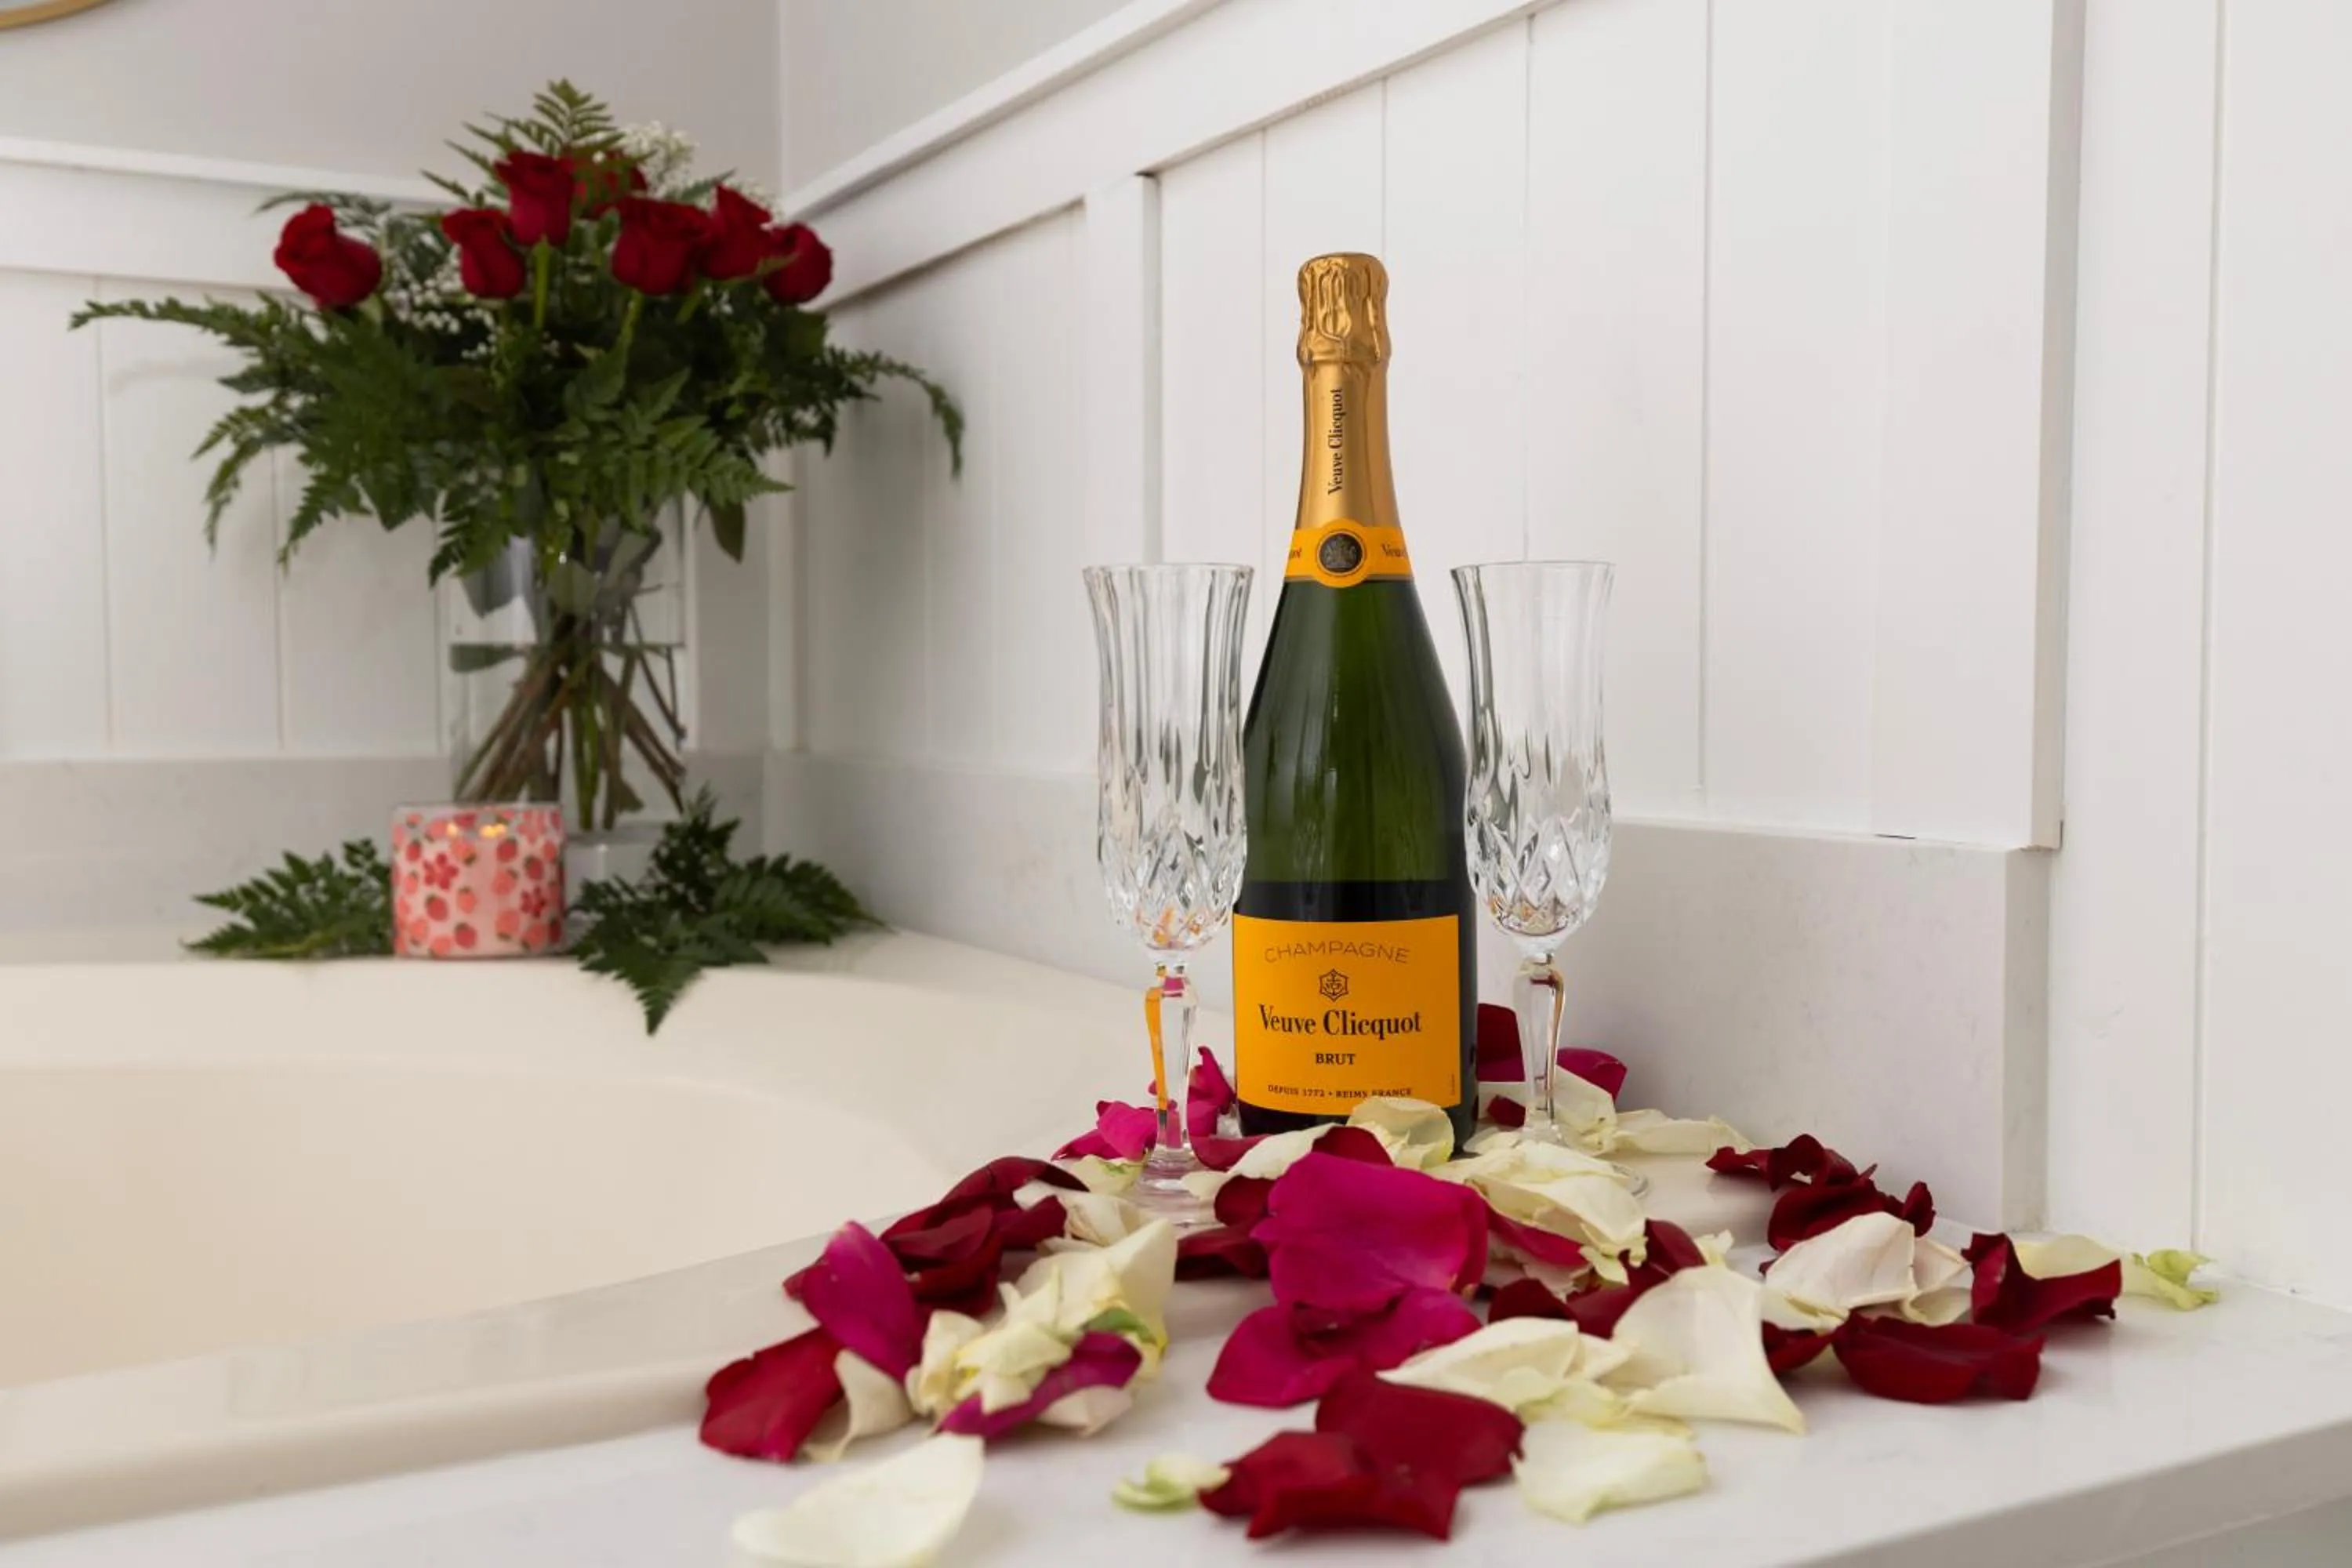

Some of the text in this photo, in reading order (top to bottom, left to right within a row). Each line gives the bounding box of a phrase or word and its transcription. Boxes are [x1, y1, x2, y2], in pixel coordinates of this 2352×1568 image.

[1327, 388, 1346, 495] Veuve Clicquot
[1264, 941, 1410, 964] CHAMPAGNE
[1258, 1004, 1422, 1041] Veuve Clicquot
[1315, 1053, 1356, 1065] BRUT
[1268, 1084, 1412, 1098] DEPUIS 1772 REIMS FRANCE
